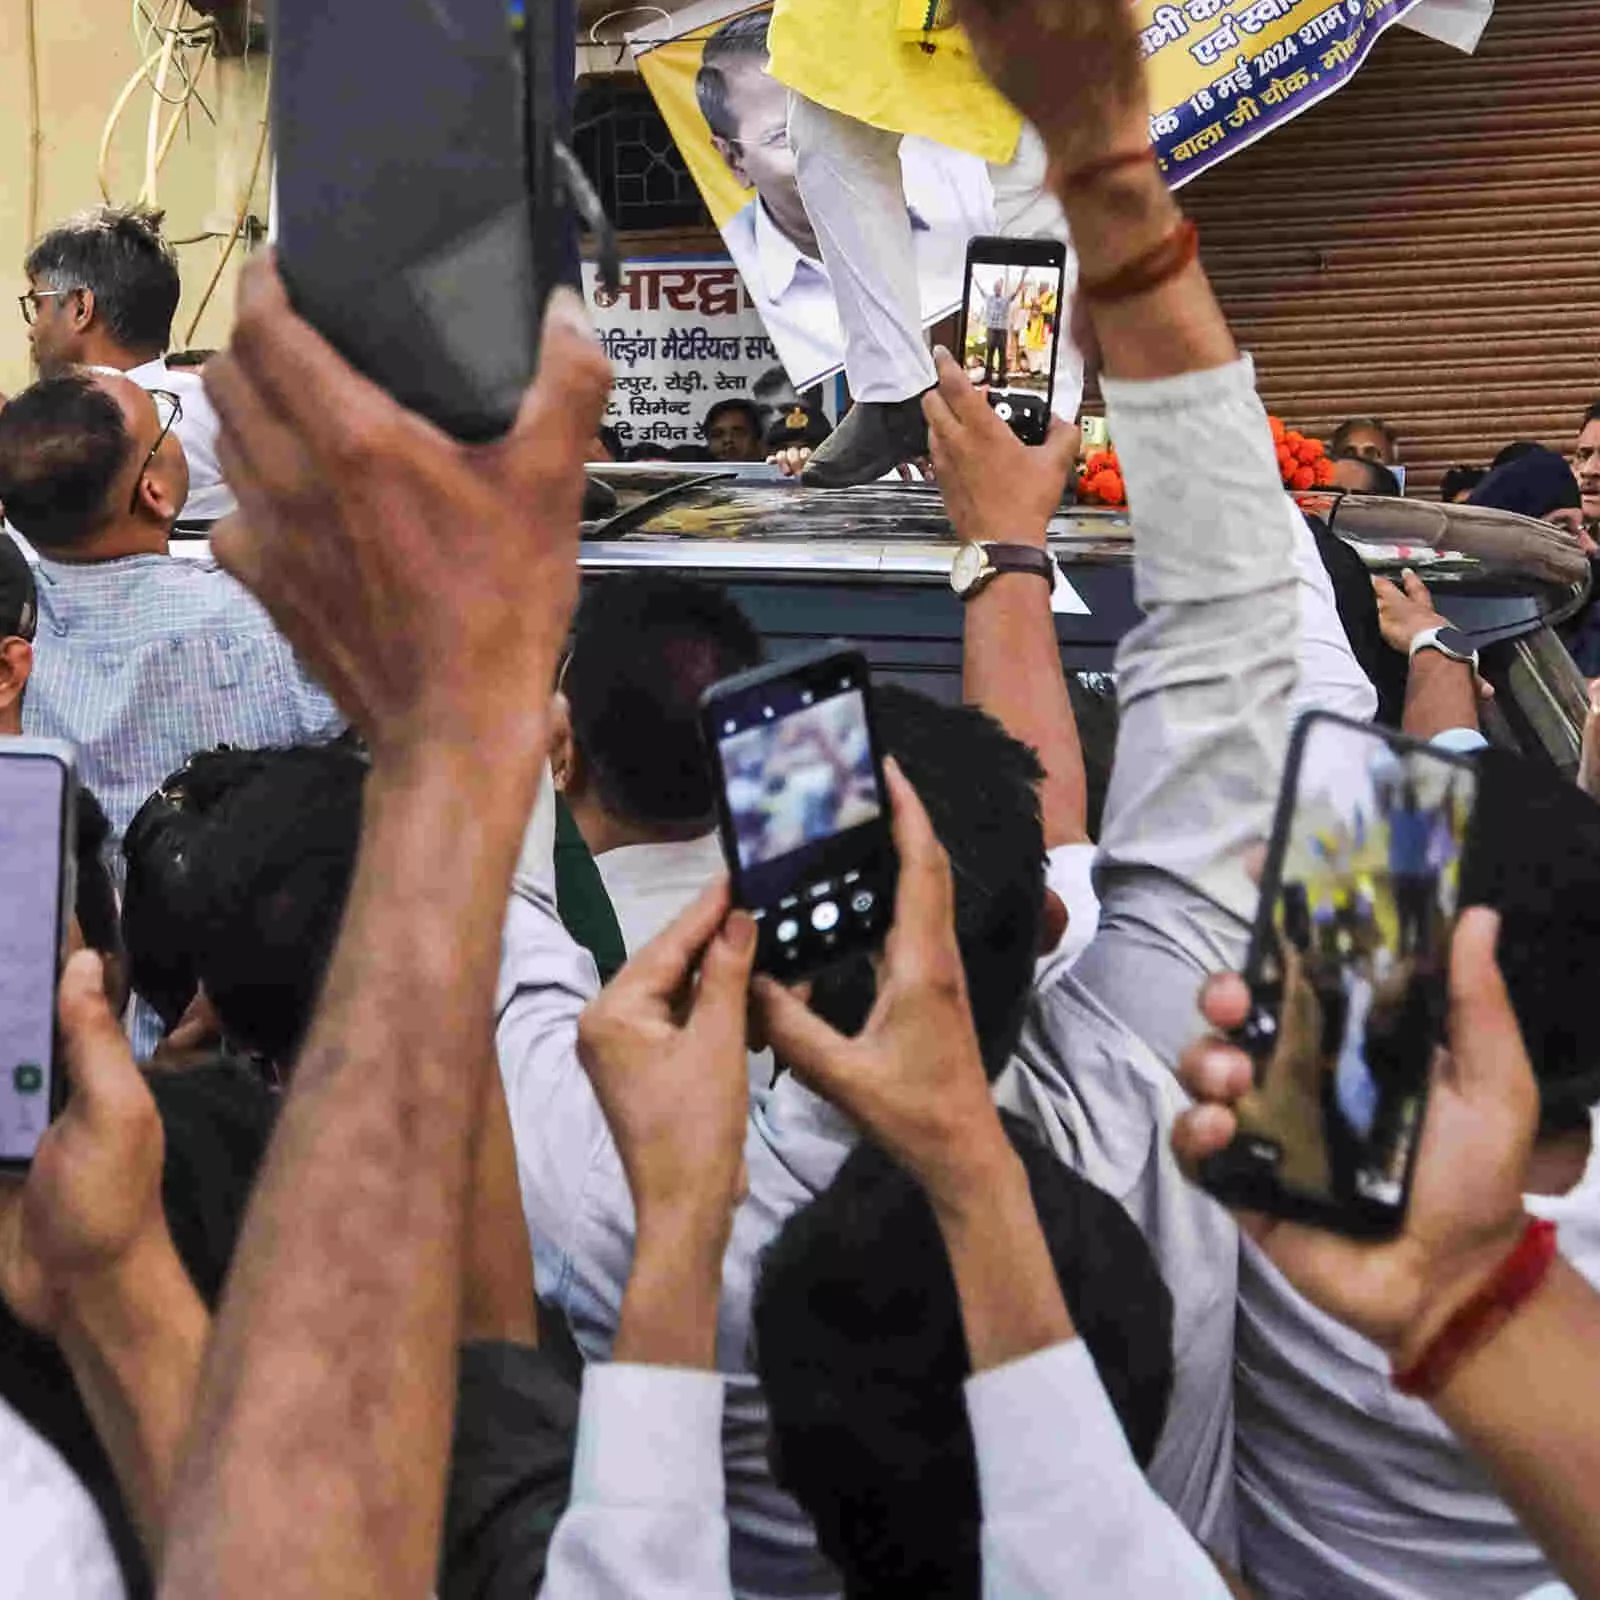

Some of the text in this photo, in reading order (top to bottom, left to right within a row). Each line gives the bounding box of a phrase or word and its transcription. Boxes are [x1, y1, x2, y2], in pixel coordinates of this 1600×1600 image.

[1190, 13, 1239, 65] एवं
[1190, 89, 1215, 116] 18
[1212, 54, 1254, 98] मई
[1253, 39, 1298, 78] 2024
[1297, 4, 1346, 46] शाम
[1170, 120, 1227, 163] बाला
[1225, 97, 1261, 128] जी
[714, 371, 748, 391] रेता
[630, 397, 691, 416] सिमेन्ट
[639, 422, 689, 441] उचित
